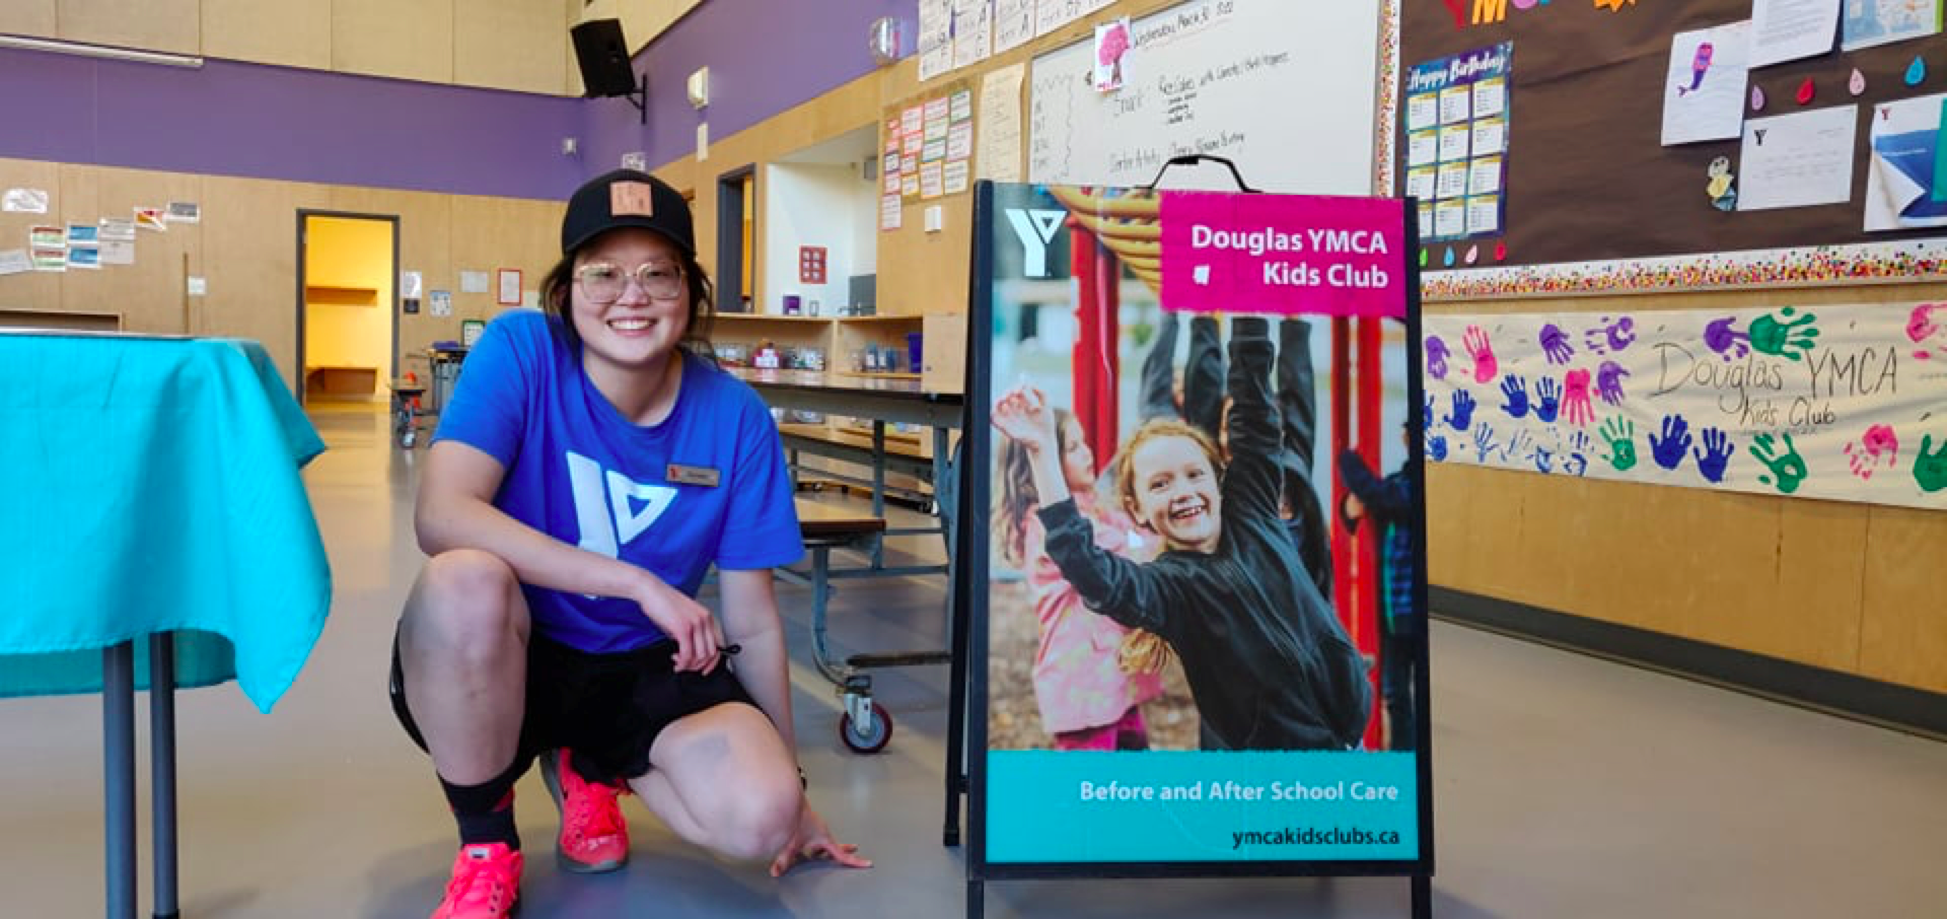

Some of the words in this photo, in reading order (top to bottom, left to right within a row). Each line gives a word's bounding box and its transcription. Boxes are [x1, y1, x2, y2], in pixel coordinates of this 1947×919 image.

[1406, 67, 1447, 91] Happy
[1449, 51, 1505, 82] Birthday
[1191, 225, 1302, 256] Douglas
[1307, 229, 1388, 254] YMCA
[1263, 261, 1322, 286] Kids
[1328, 264, 1389, 288] Club
[1650, 341, 1784, 415] Douglas
[1805, 346, 1898, 400] YMCA
[1739, 398, 1777, 428] Kids
[1788, 397, 1836, 426] Club
[1080, 780, 1154, 800] Before
[1159, 780, 1201, 800] and
[1208, 780, 1264, 800] After
[1271, 781, 1343, 801] School
[1350, 781, 1399, 801] Care
[1233, 828, 1400, 850] ymcakidsclubs.ca
